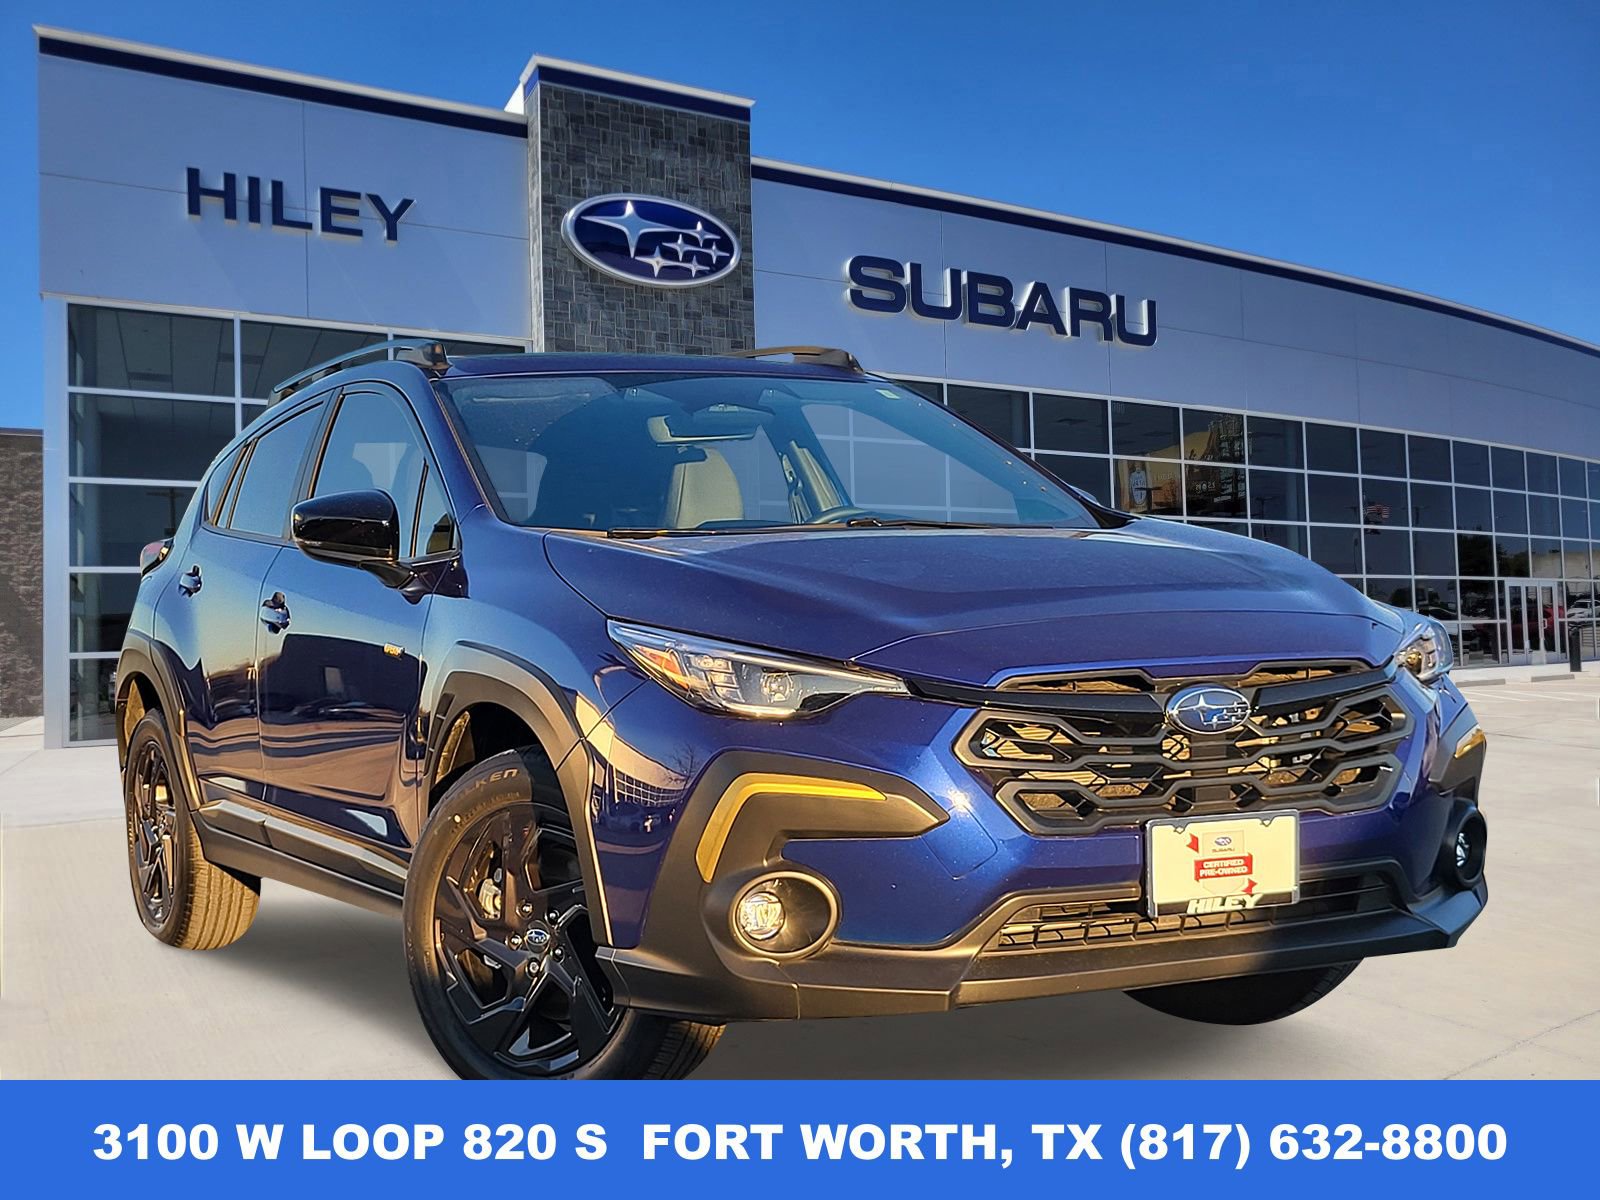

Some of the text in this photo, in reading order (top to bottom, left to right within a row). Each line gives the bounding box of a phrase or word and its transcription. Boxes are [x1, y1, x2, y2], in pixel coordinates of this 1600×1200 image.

[187, 168, 414, 242] HILEY
[849, 255, 1158, 347] SUBARU
[1199, 867, 1248, 877] PRE-OWNED
[1203, 859, 1244, 868] CERTIFIED
[1187, 893, 1262, 914] HILEY
